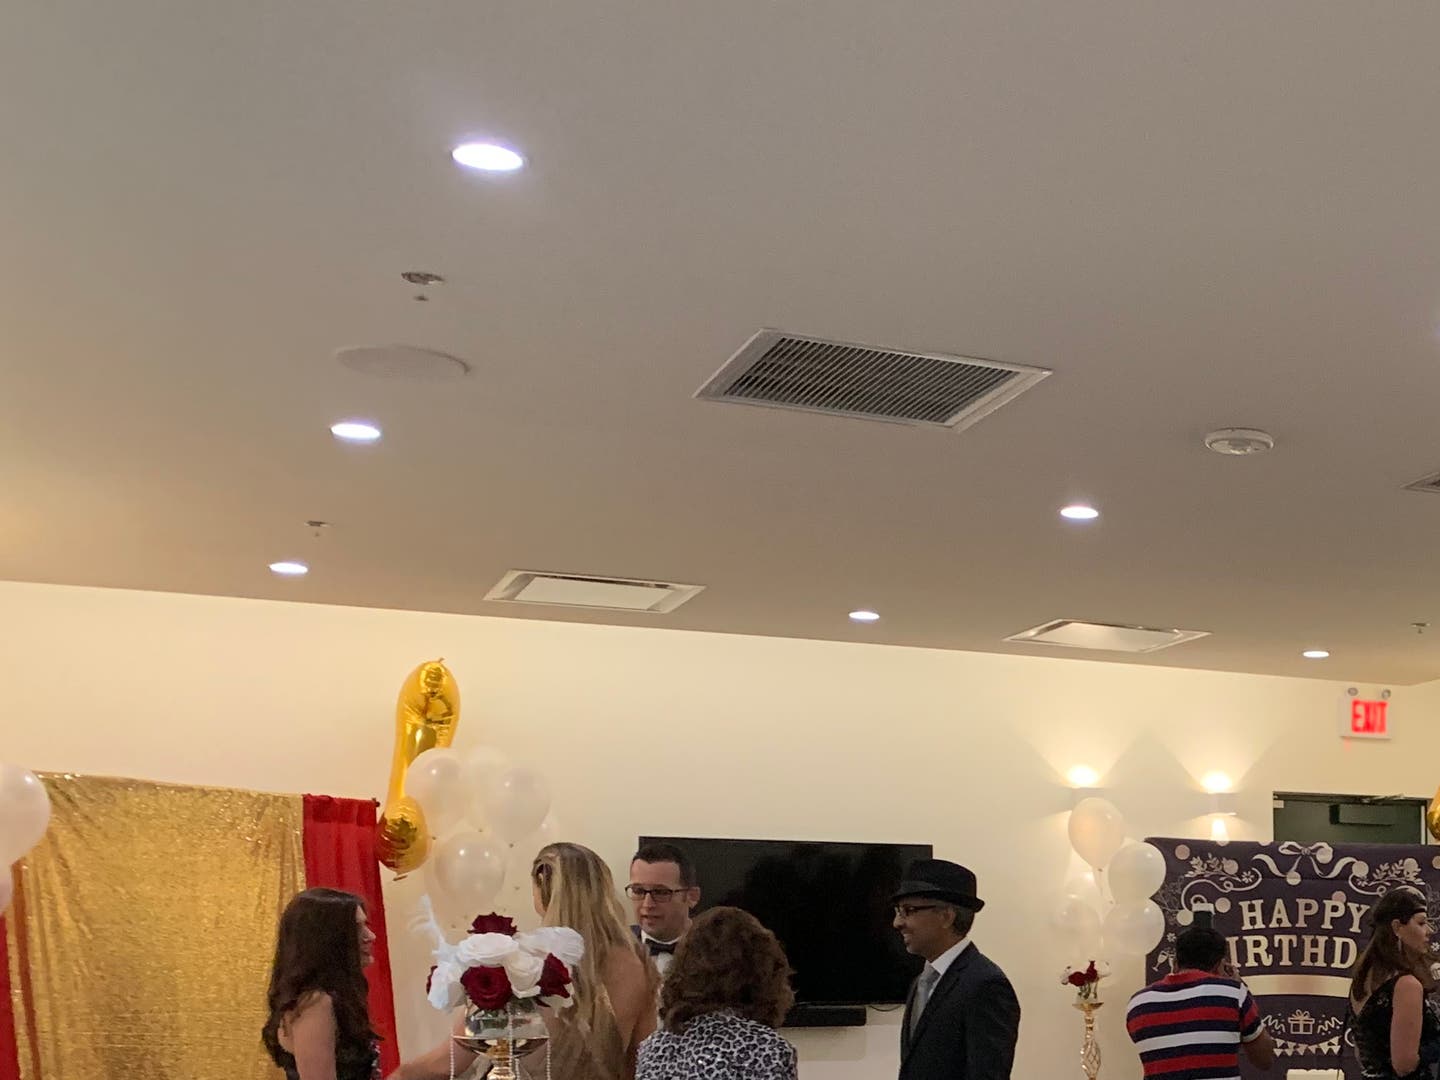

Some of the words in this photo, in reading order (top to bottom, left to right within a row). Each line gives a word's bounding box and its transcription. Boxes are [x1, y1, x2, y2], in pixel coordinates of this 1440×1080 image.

[1351, 699, 1388, 734] EXIT
[1238, 898, 1370, 933] HAPPY
[1225, 934, 1358, 969] IRTHD
